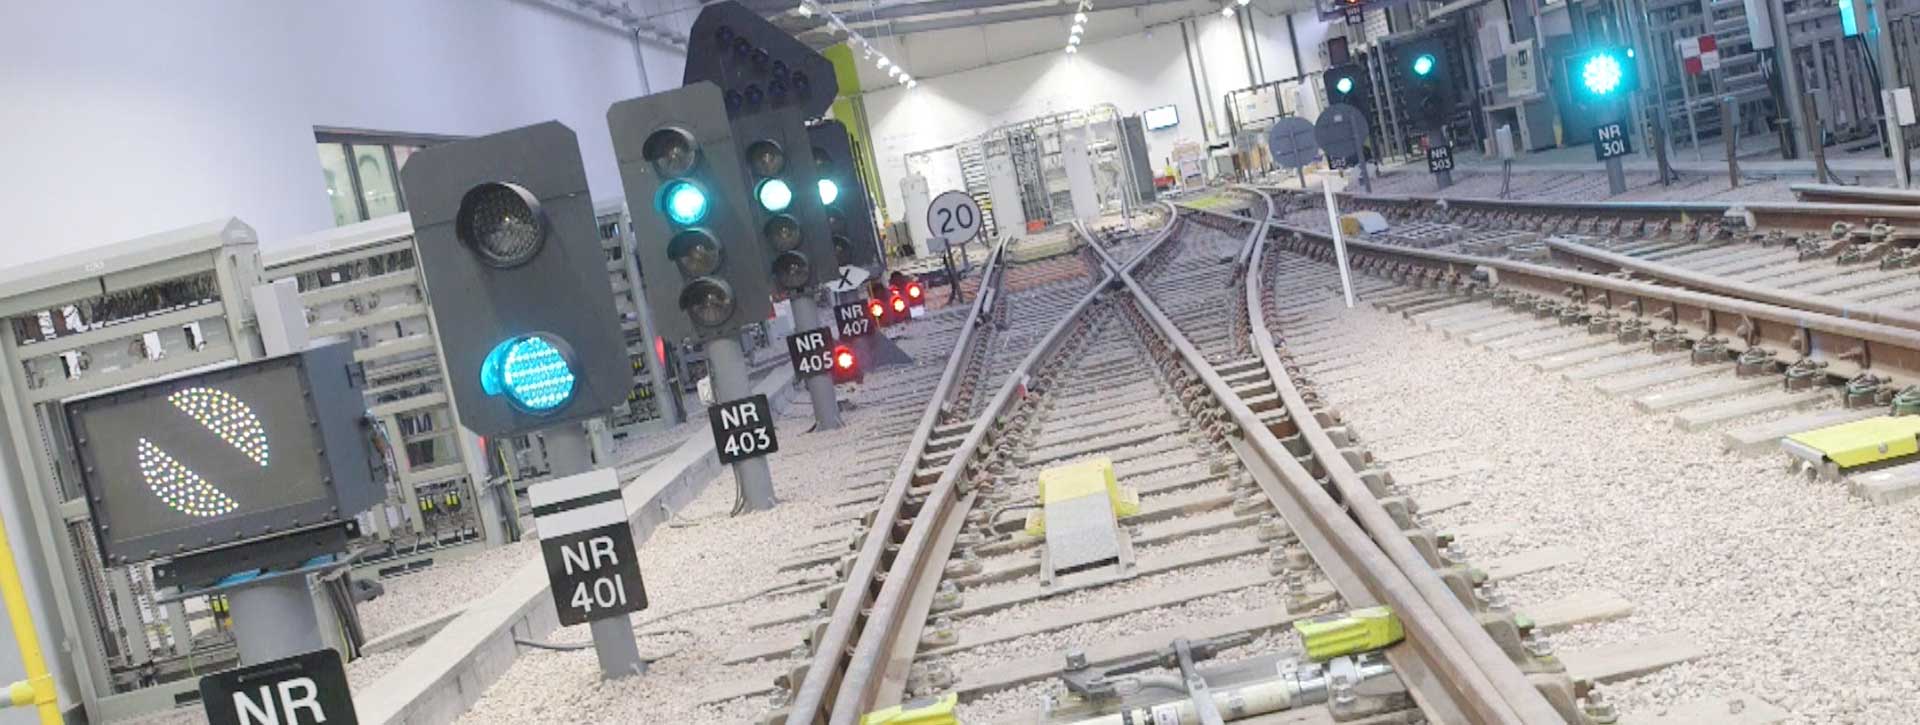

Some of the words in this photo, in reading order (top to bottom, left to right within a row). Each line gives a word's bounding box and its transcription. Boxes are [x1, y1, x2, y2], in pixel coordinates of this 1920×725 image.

[1598, 125, 1621, 140] NR
[1431, 147, 1448, 159] NR
[1602, 139, 1625, 156] 301
[1432, 159, 1451, 170] 303
[937, 203, 973, 234] 20
[838, 268, 853, 289] X
[841, 304, 864, 320] NR
[843, 319, 869, 336] 407
[795, 332, 825, 353] NR
[799, 351, 833, 373] 405
[720, 402, 759, 430] NR
[725, 426, 770, 456] 403
[560, 535, 619, 576] NR
[571, 574, 627, 612] 401
[232, 677, 327, 725] NR
